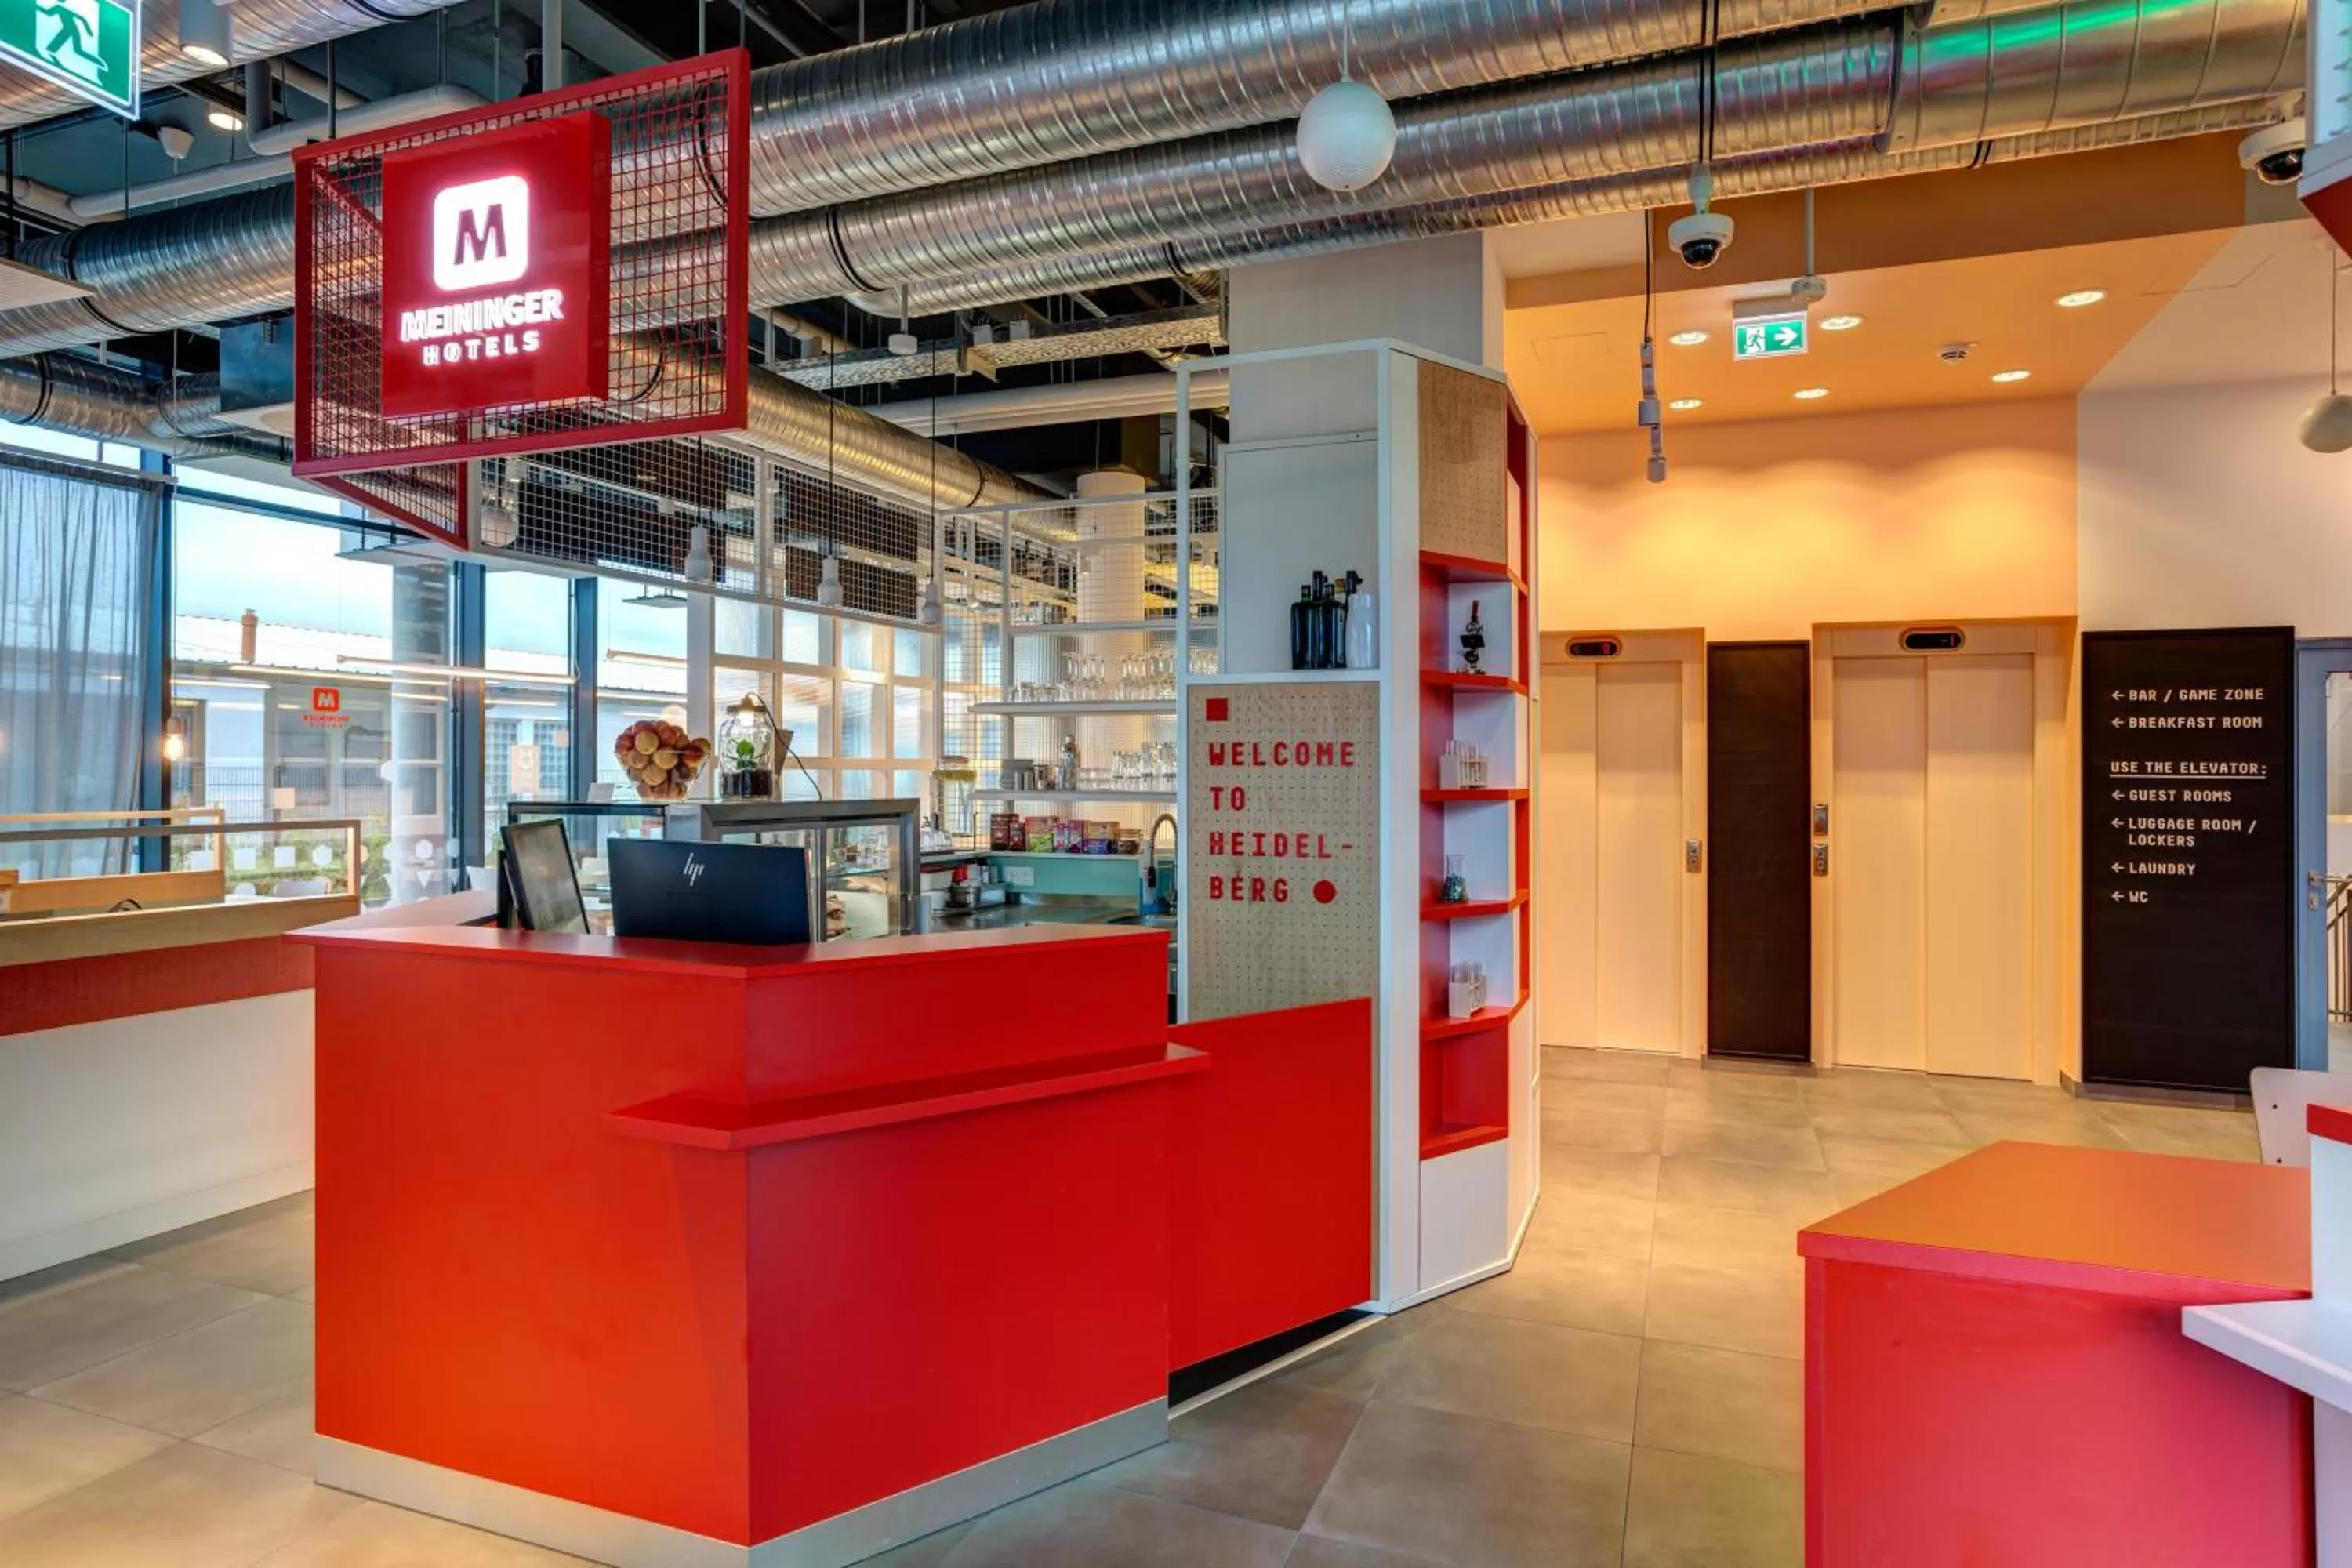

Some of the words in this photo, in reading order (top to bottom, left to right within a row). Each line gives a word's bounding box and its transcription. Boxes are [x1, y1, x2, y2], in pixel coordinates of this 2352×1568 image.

[453, 203, 508, 266] M
[400, 288, 564, 343] MEININGER
[423, 330, 540, 365] HOTELS
[2129, 689, 2157, 701] BAR
[2163, 689, 2172, 703] /
[2178, 689, 2218, 701] GAME
[2224, 688, 2264, 701] ZONE
[2129, 717, 2216, 728] BREAKFAST
[2222, 717, 2263, 728] ROOM
[1208, 741, 1355, 766] WELCOME
[2110, 761, 2139, 773] USE
[2144, 761, 2173, 774] THE
[2180, 762, 2267, 775] ELEVATOR:
[1209, 786, 1246, 811] TO
[2129, 789, 2176, 802] GUEST
[2183, 790, 2233, 803] ROOMS
[2129, 818, 2195, 831] LUGGAGE
[2201, 819, 2241, 832] ROOM
[2248, 819, 2257, 834] /
[1209, 831, 1353, 859] HEIDEL-
[2129, 834, 2196, 848] LOCKERS
[683, 852, 705, 887] hp
[2129, 862, 2196, 876] LAUNDRY
[1209, 876, 1289, 902] BERG
[2129, 891, 2149, 903] WC
